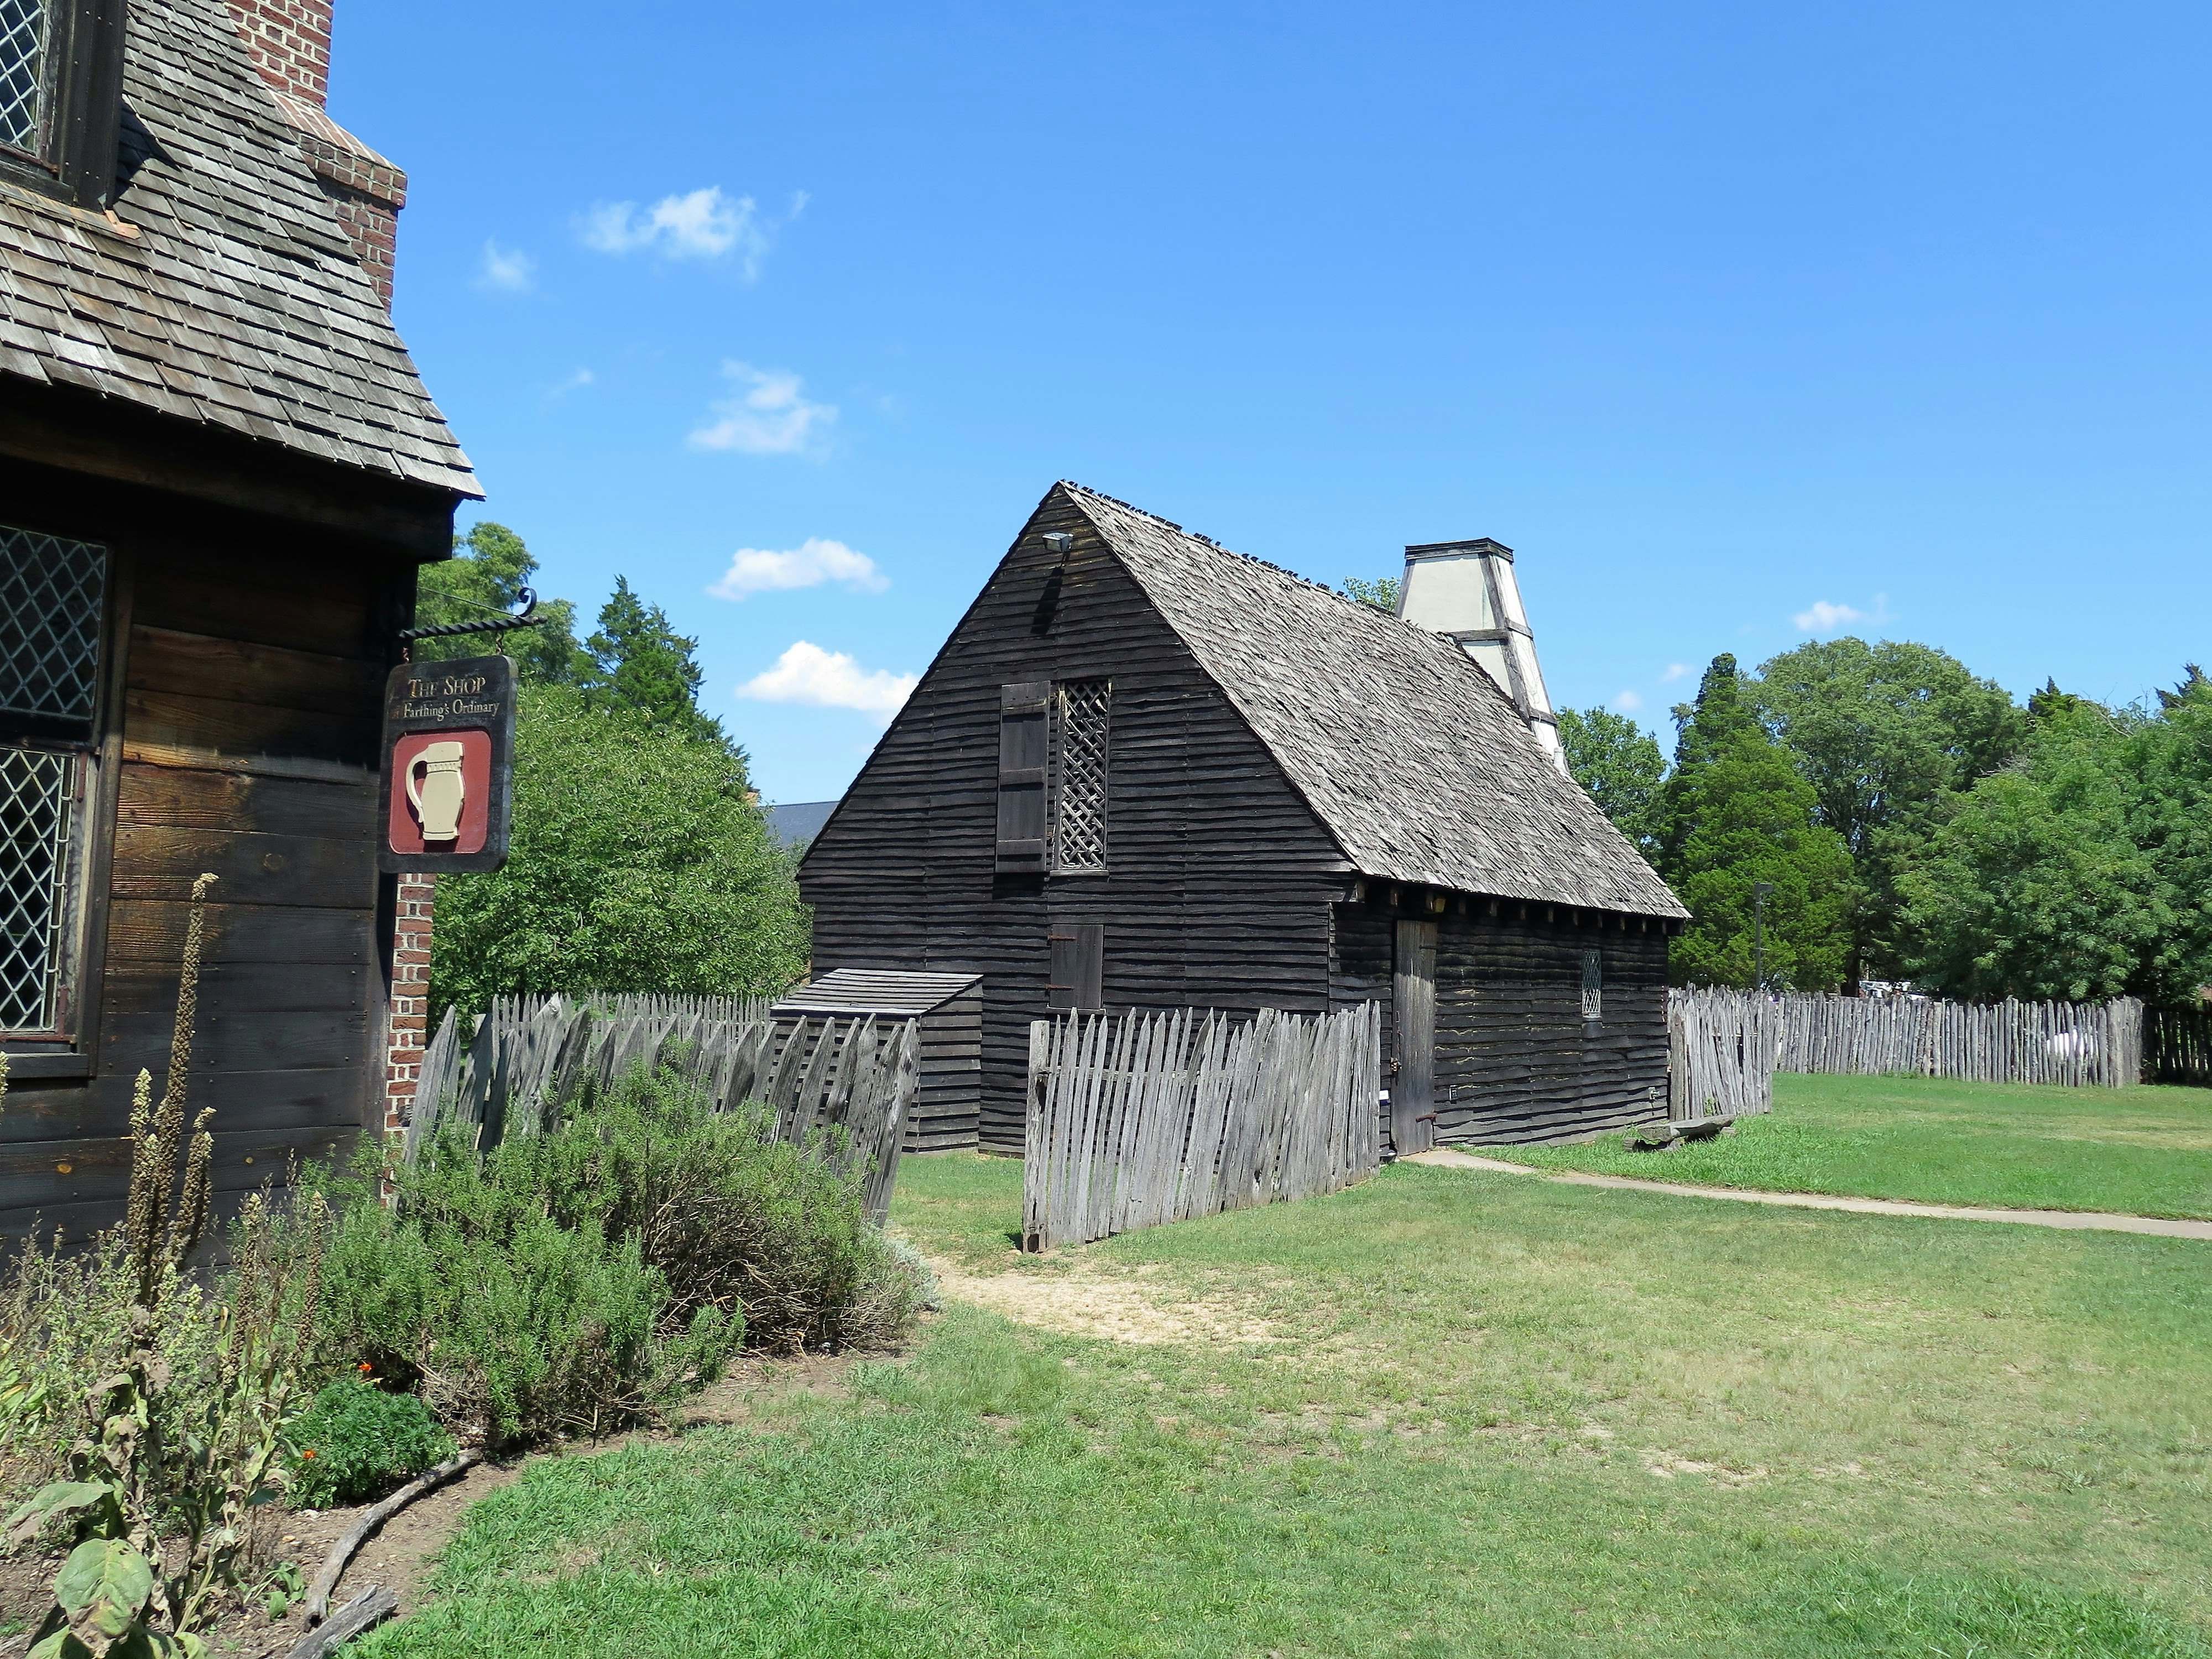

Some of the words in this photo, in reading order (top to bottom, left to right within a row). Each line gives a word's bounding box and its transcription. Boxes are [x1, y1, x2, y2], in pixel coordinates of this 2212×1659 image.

[408, 679, 439, 698] THE
[444, 675, 486, 696] SHOP
[403, 702, 450, 721] Farthing's
[452, 699, 500, 717] Ordinary
